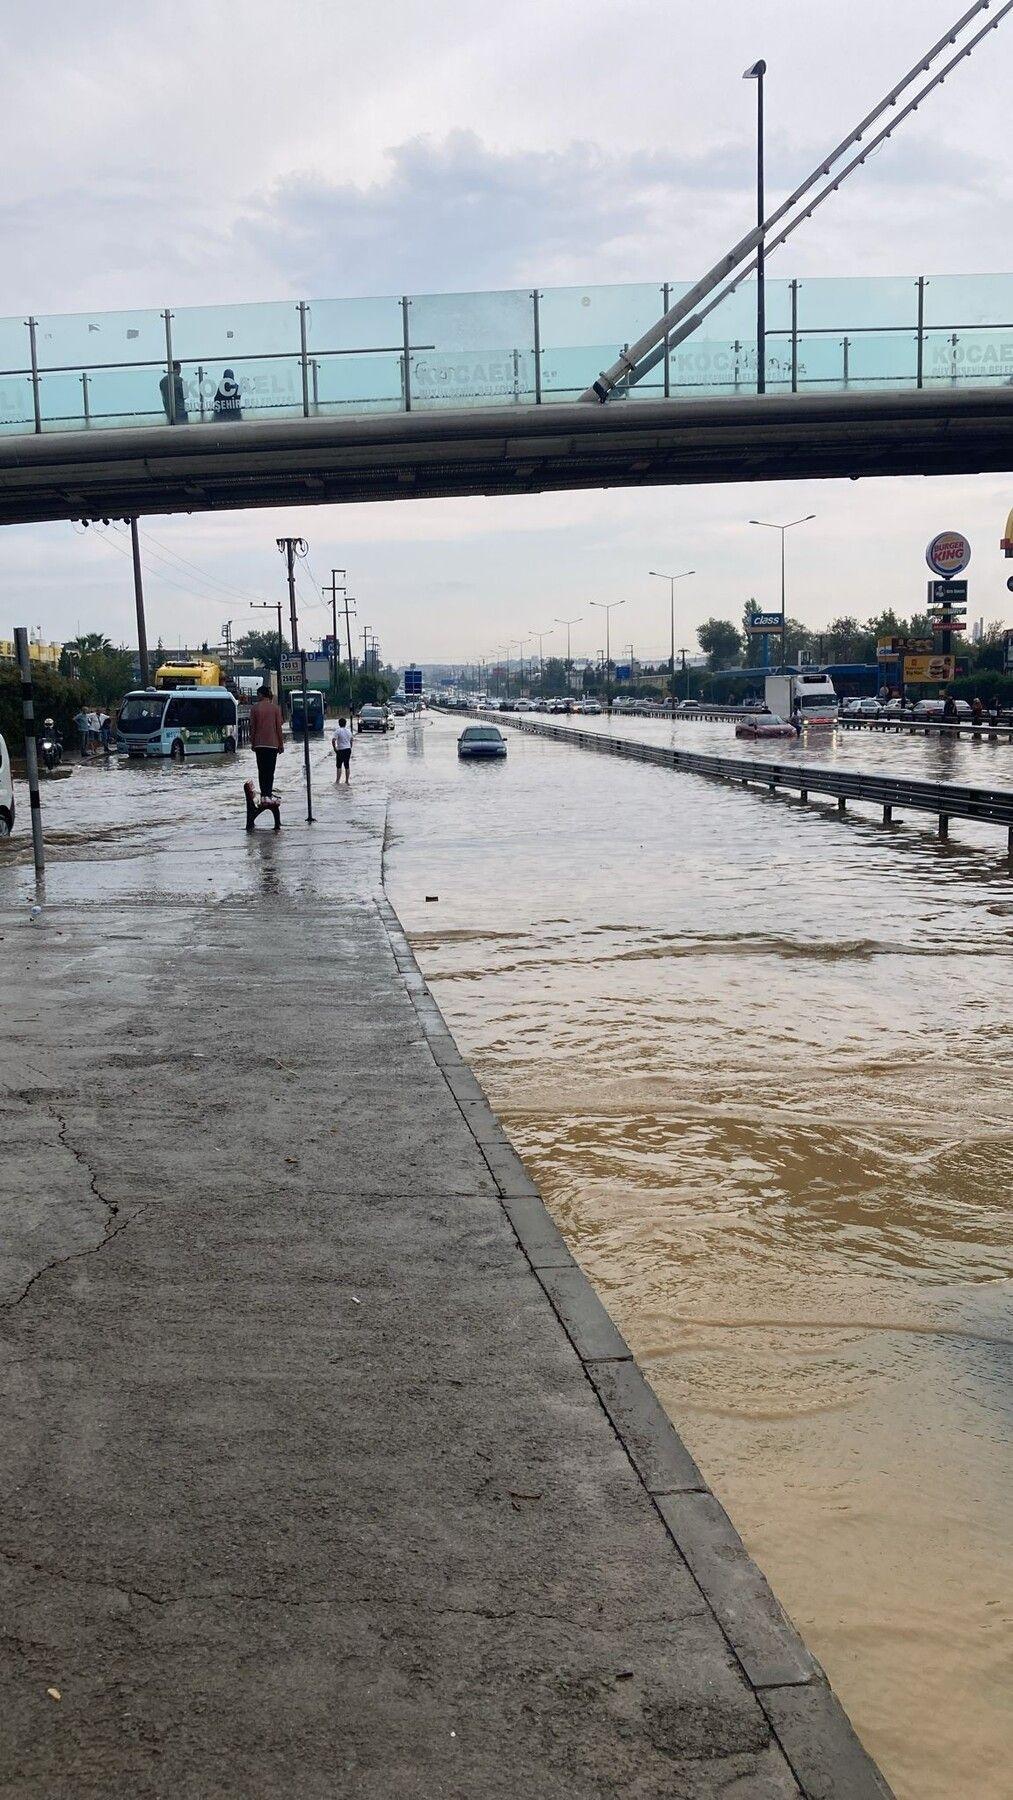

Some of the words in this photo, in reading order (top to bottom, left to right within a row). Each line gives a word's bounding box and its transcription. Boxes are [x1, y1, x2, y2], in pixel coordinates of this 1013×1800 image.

[934, 542, 964, 552] BURGER
[933, 550, 964, 562] KING
[753, 615, 780, 625] class
